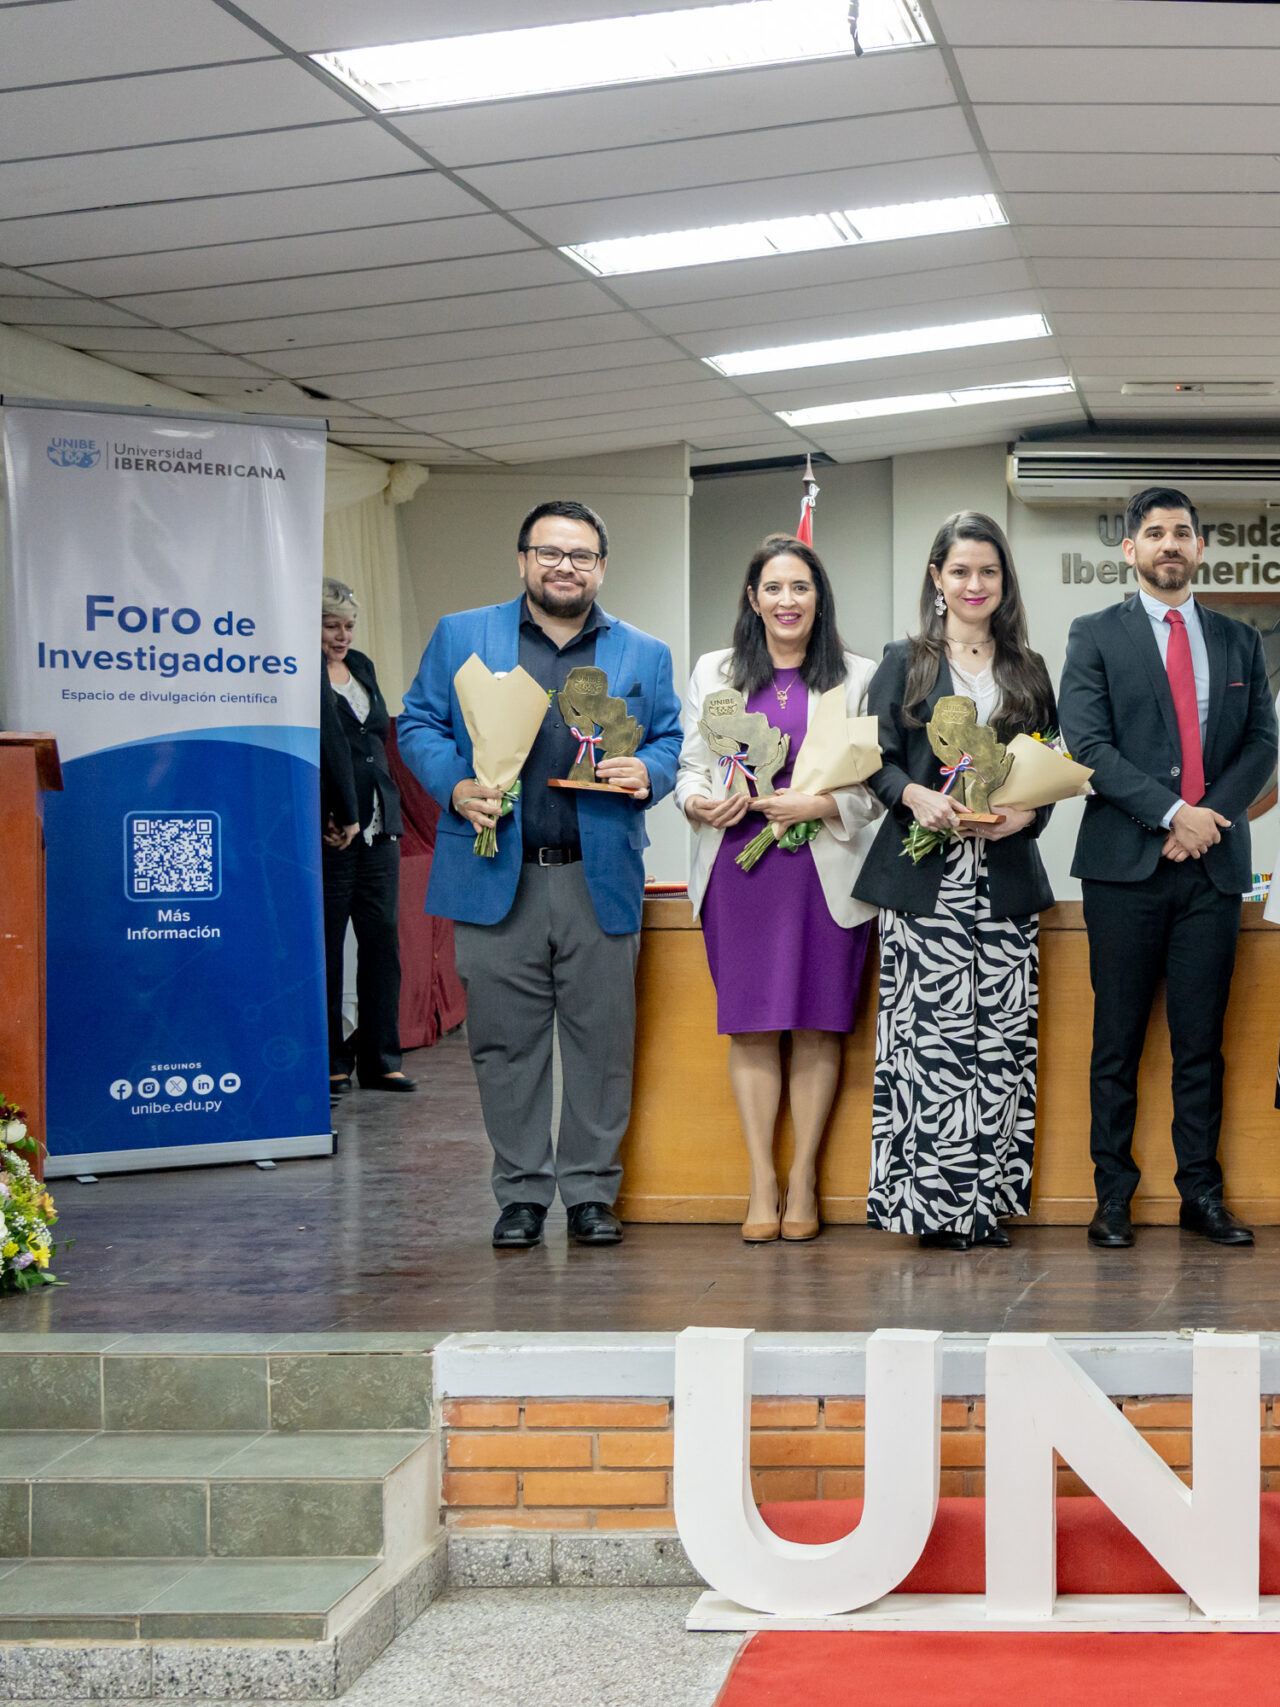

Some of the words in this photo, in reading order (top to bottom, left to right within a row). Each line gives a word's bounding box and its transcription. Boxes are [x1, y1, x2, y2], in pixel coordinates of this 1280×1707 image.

[51, 437, 96, 450] UNIBE
[114, 443, 203, 460] Universidad
[114, 457, 286, 481] IBEROAMERICANA
[86, 595, 201, 635] Foro
[213, 611, 256, 637] de
[38, 642, 298, 678] Investigadores
[61, 688, 115, 702] Espacio
[118, 690, 136, 701] de
[139, 691, 216, 704] divulgación
[219, 692, 278, 704] científica
[157, 908, 191, 922] Más
[127, 925, 221, 940] Información
[151, 1062, 202, 1071] SEGUINOS
[131, 1100, 222, 1115] unibe.edu.py
